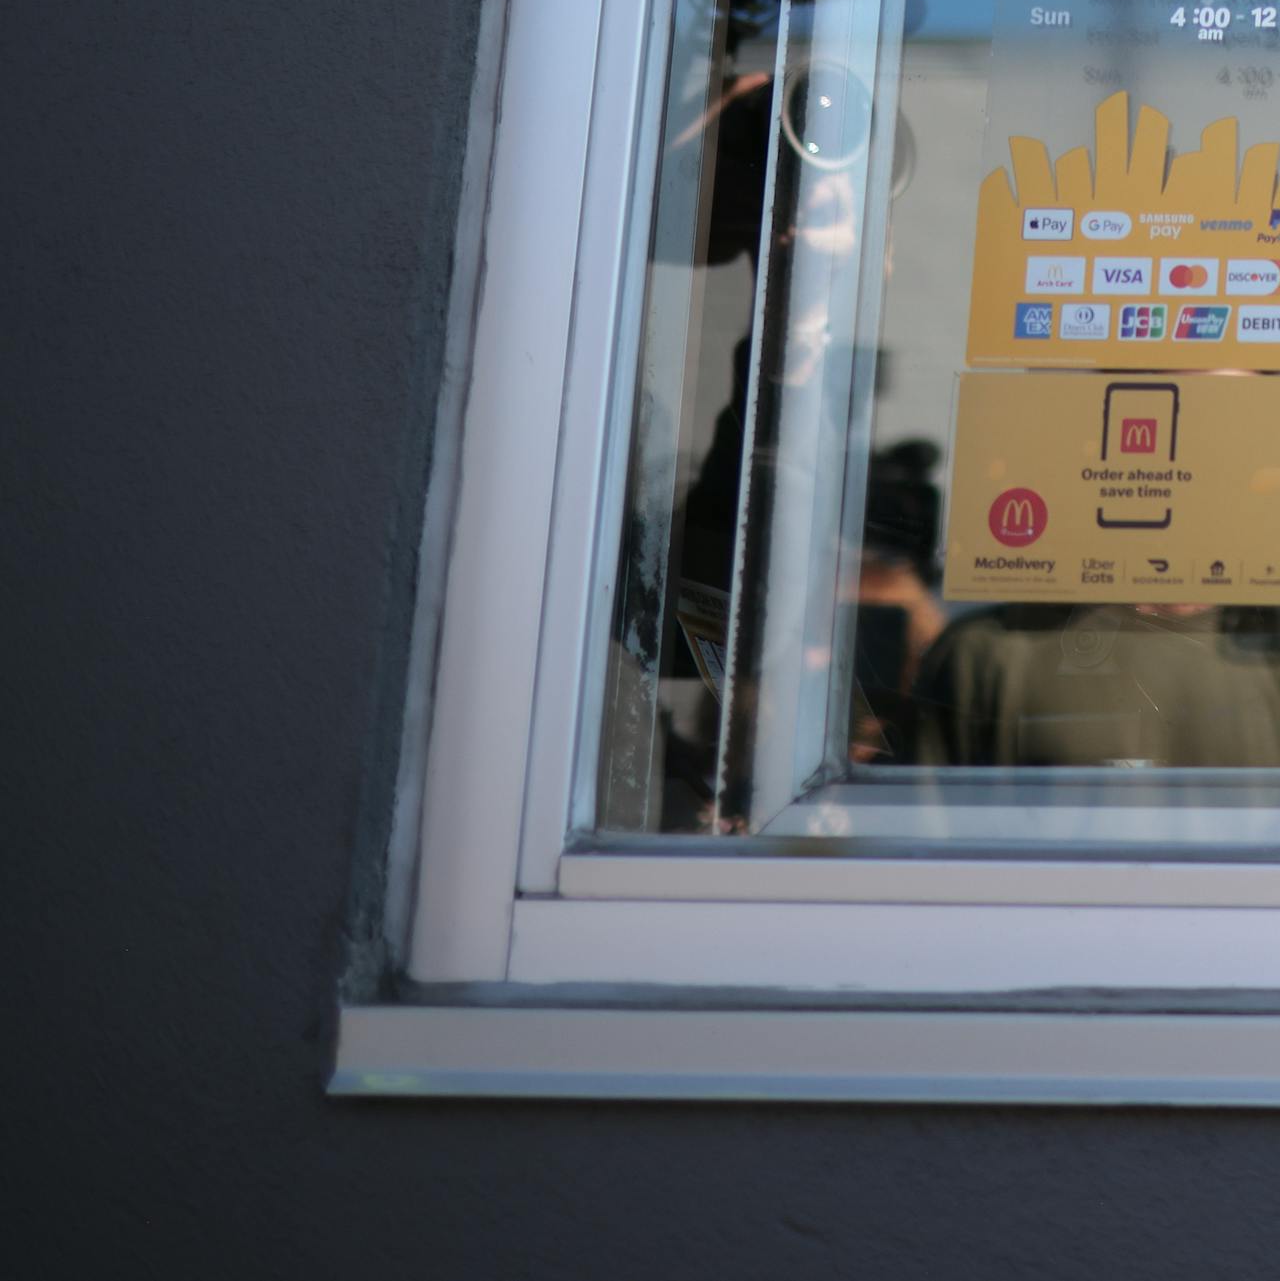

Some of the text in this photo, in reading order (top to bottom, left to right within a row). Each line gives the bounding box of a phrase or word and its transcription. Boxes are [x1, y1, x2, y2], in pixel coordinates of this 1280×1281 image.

[1030, 8, 1070, 26] Sun
[1198, 28, 1223, 41] am
[1042, 218, 1067, 233] Pay
[1103, 219, 1124, 233] Pay
[1139, 213, 1194, 224] SAMSUNG
[1200, 220, 1253, 231] venmo
[1151, 225, 1181, 239] pay
[1103, 269, 1144, 284] VISA
[1228, 272, 1278, 282] DISCOVER
[1122, 316, 1163, 328] JCB
[1081, 467, 1192, 482] Order ahead to
[1099, 484, 1172, 499] save time
[974, 556, 1056, 574] McDelivery
[1082, 558, 1115, 572] Uber
[1081, 571, 1115, 585] Eats
